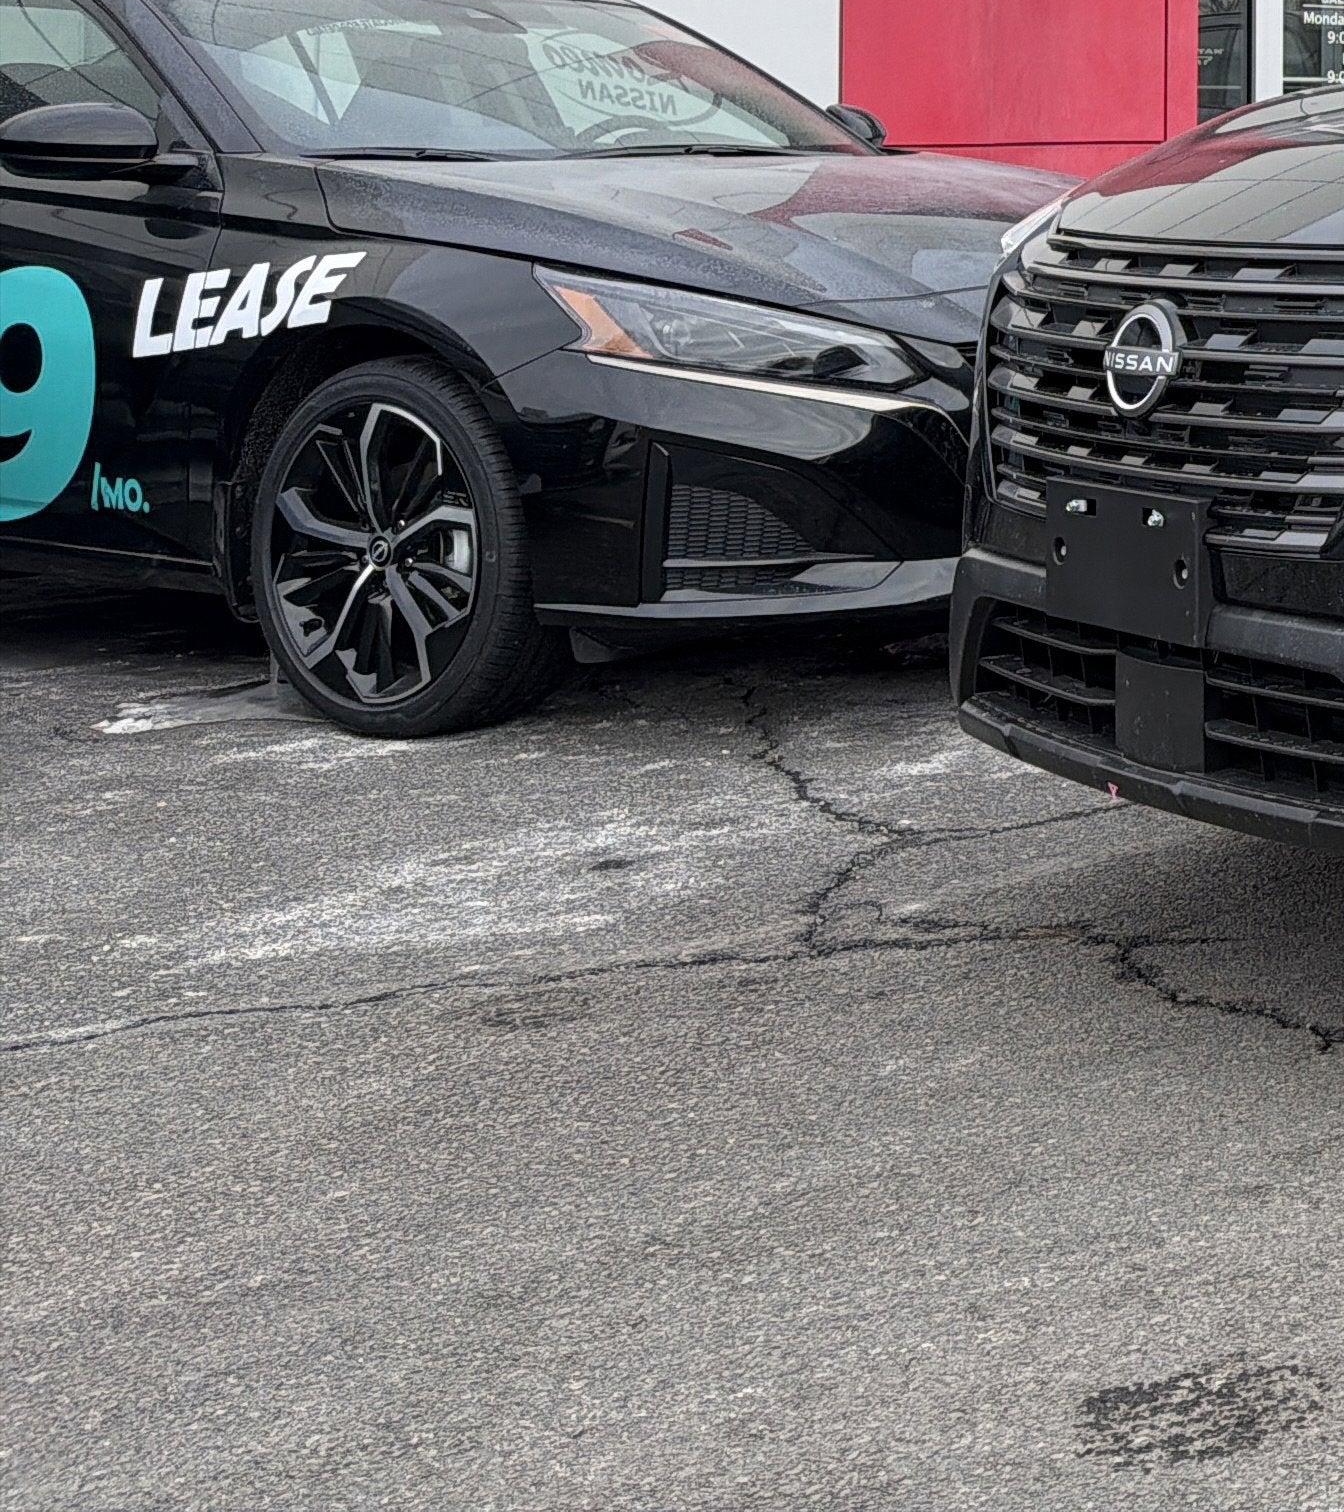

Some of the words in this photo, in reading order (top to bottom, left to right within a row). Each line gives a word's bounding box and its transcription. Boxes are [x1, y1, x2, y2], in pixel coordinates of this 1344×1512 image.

[133, 251, 367, 358] LEASE
[0, 265, 96, 522] 9
[1104, 350, 1174, 373] NISSAN
[90, 461, 150, 514] /MO.
